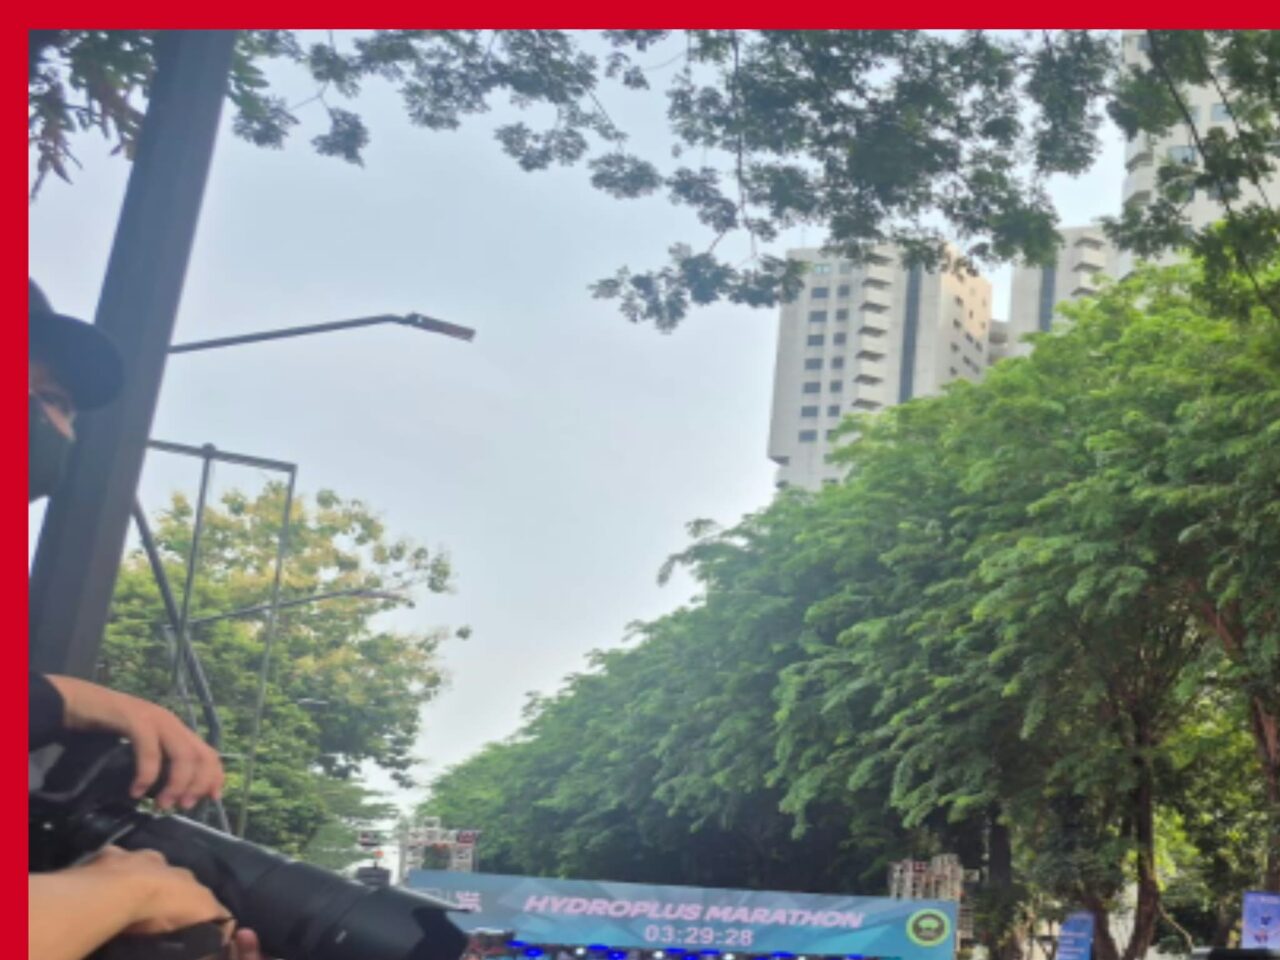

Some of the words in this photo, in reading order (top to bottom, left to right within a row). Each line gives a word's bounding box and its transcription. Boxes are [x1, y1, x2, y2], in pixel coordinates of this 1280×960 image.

[523, 894, 701, 920] HYDROPLUS
[705, 905, 864, 928] MARATHON
[644, 924, 754, 947] 03:29:28
